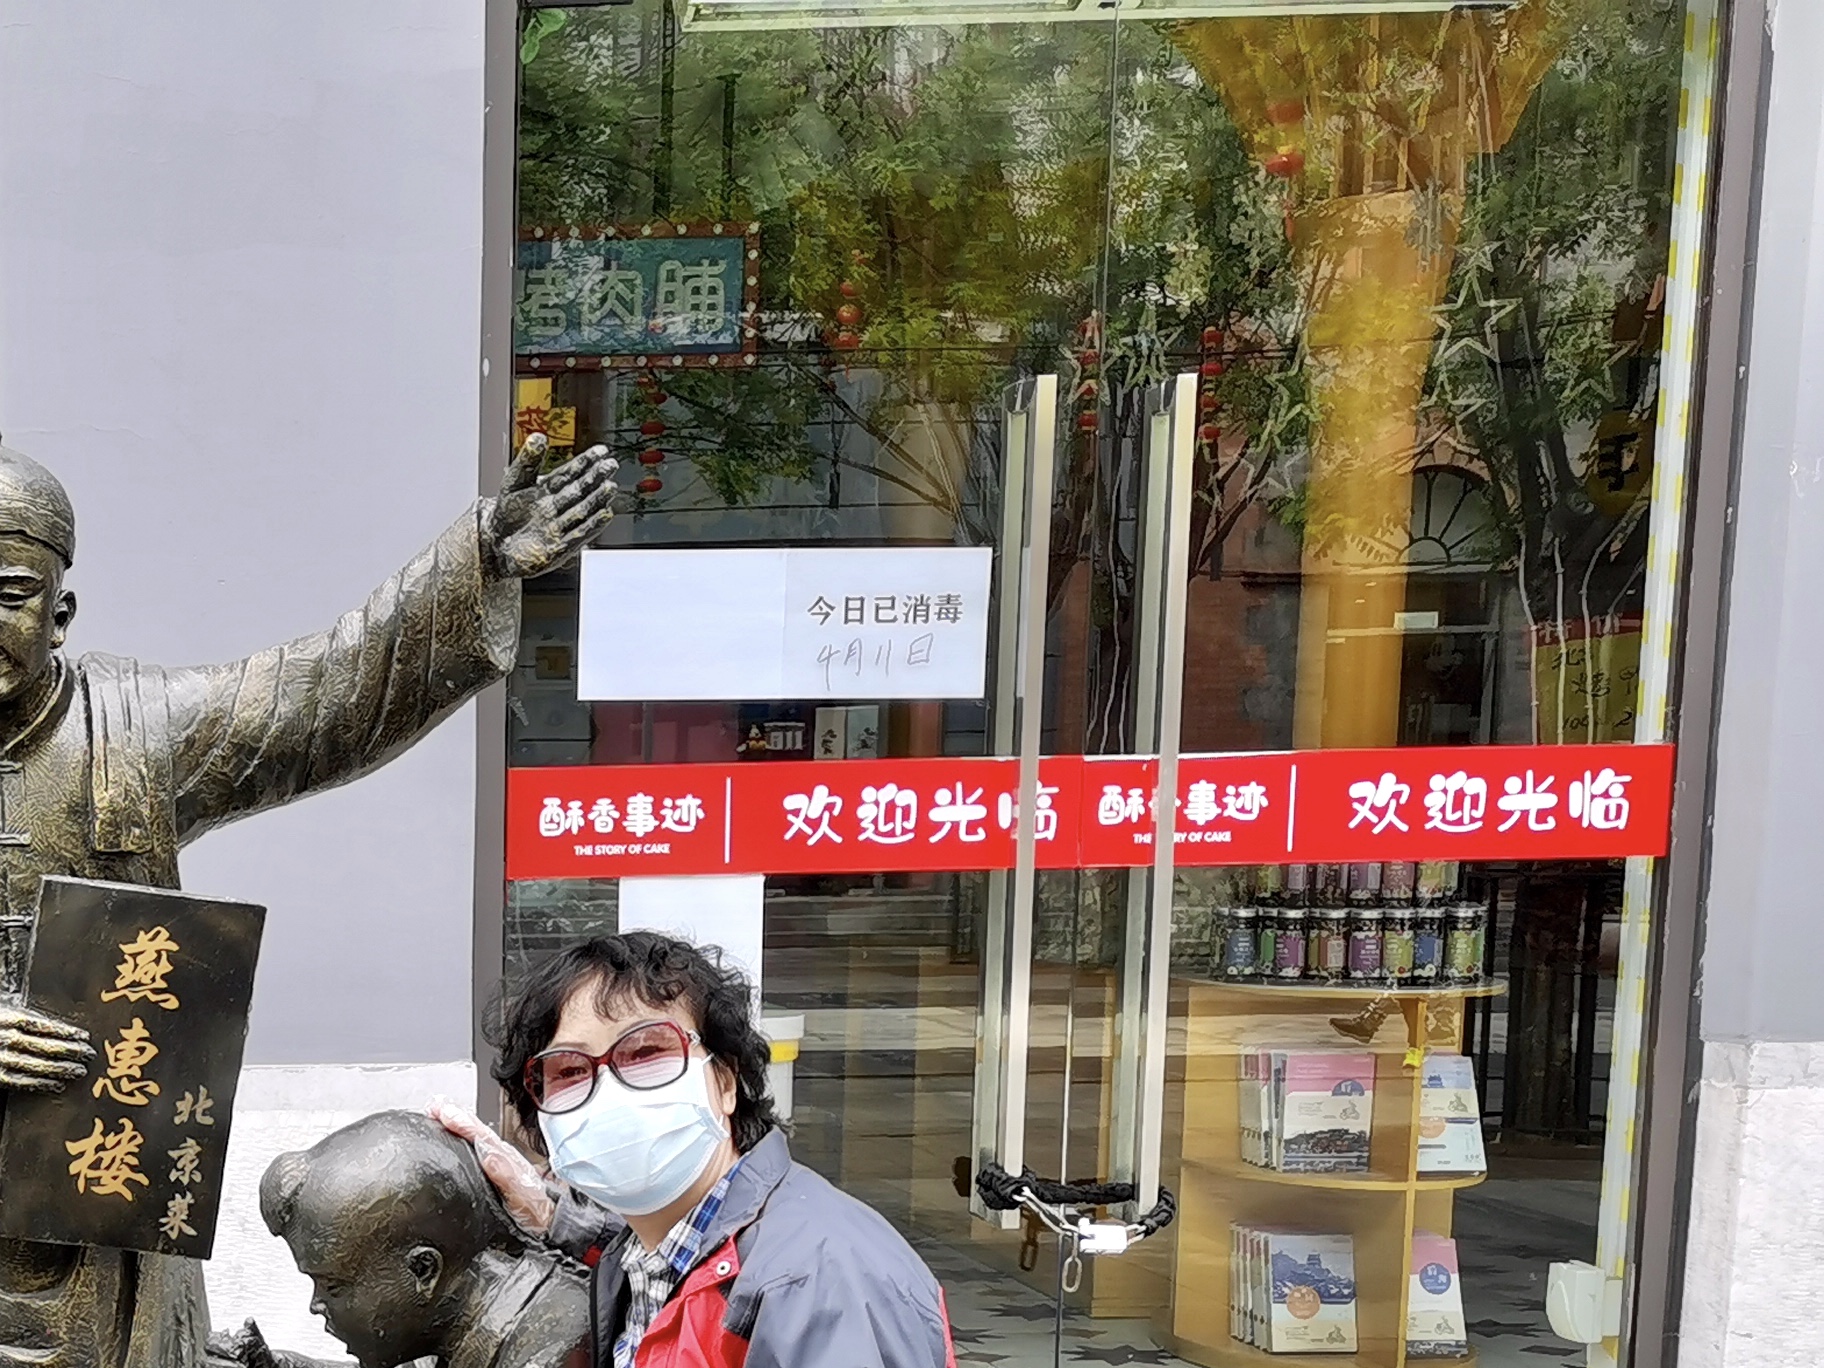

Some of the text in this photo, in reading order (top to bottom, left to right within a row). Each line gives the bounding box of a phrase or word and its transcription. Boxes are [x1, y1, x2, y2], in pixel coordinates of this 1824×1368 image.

[807, 593, 963, 626] 今日已消毒
[538, 792, 706, 837] 酥香事迹
[782, 780, 1060, 845] 欢迎光临
[1097, 779, 1269, 826] 酥事迹
[1348, 767, 1633, 834] 欢迎光临
[574, 843, 671, 856] THE STORY OF CAKE
[1203, 831, 1232, 843] CAKE
